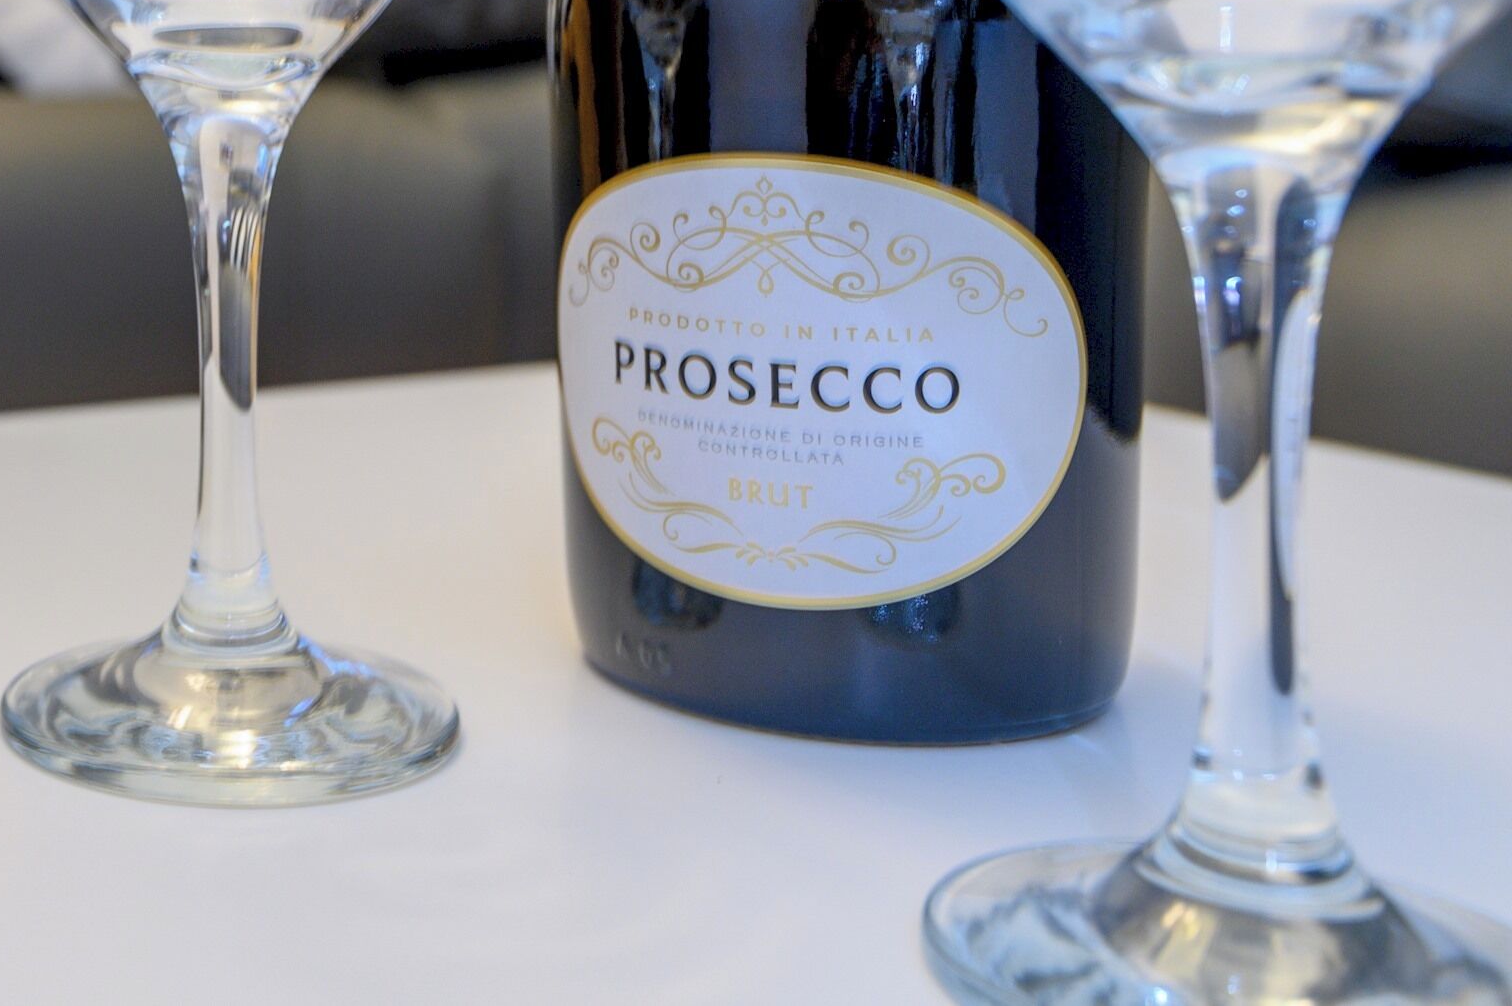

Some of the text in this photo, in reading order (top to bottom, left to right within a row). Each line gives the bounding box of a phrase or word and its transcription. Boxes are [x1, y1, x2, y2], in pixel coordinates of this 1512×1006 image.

[628, 307, 934, 343] PRODOTTO IN ITALIA
[614, 339, 961, 415] PROSECCO
[637, 409, 925, 449] DENOMINAZIONE DI ORIGINE
[697, 439, 845, 466] CONTROLLATA
[727, 476, 814, 509] BRUT
